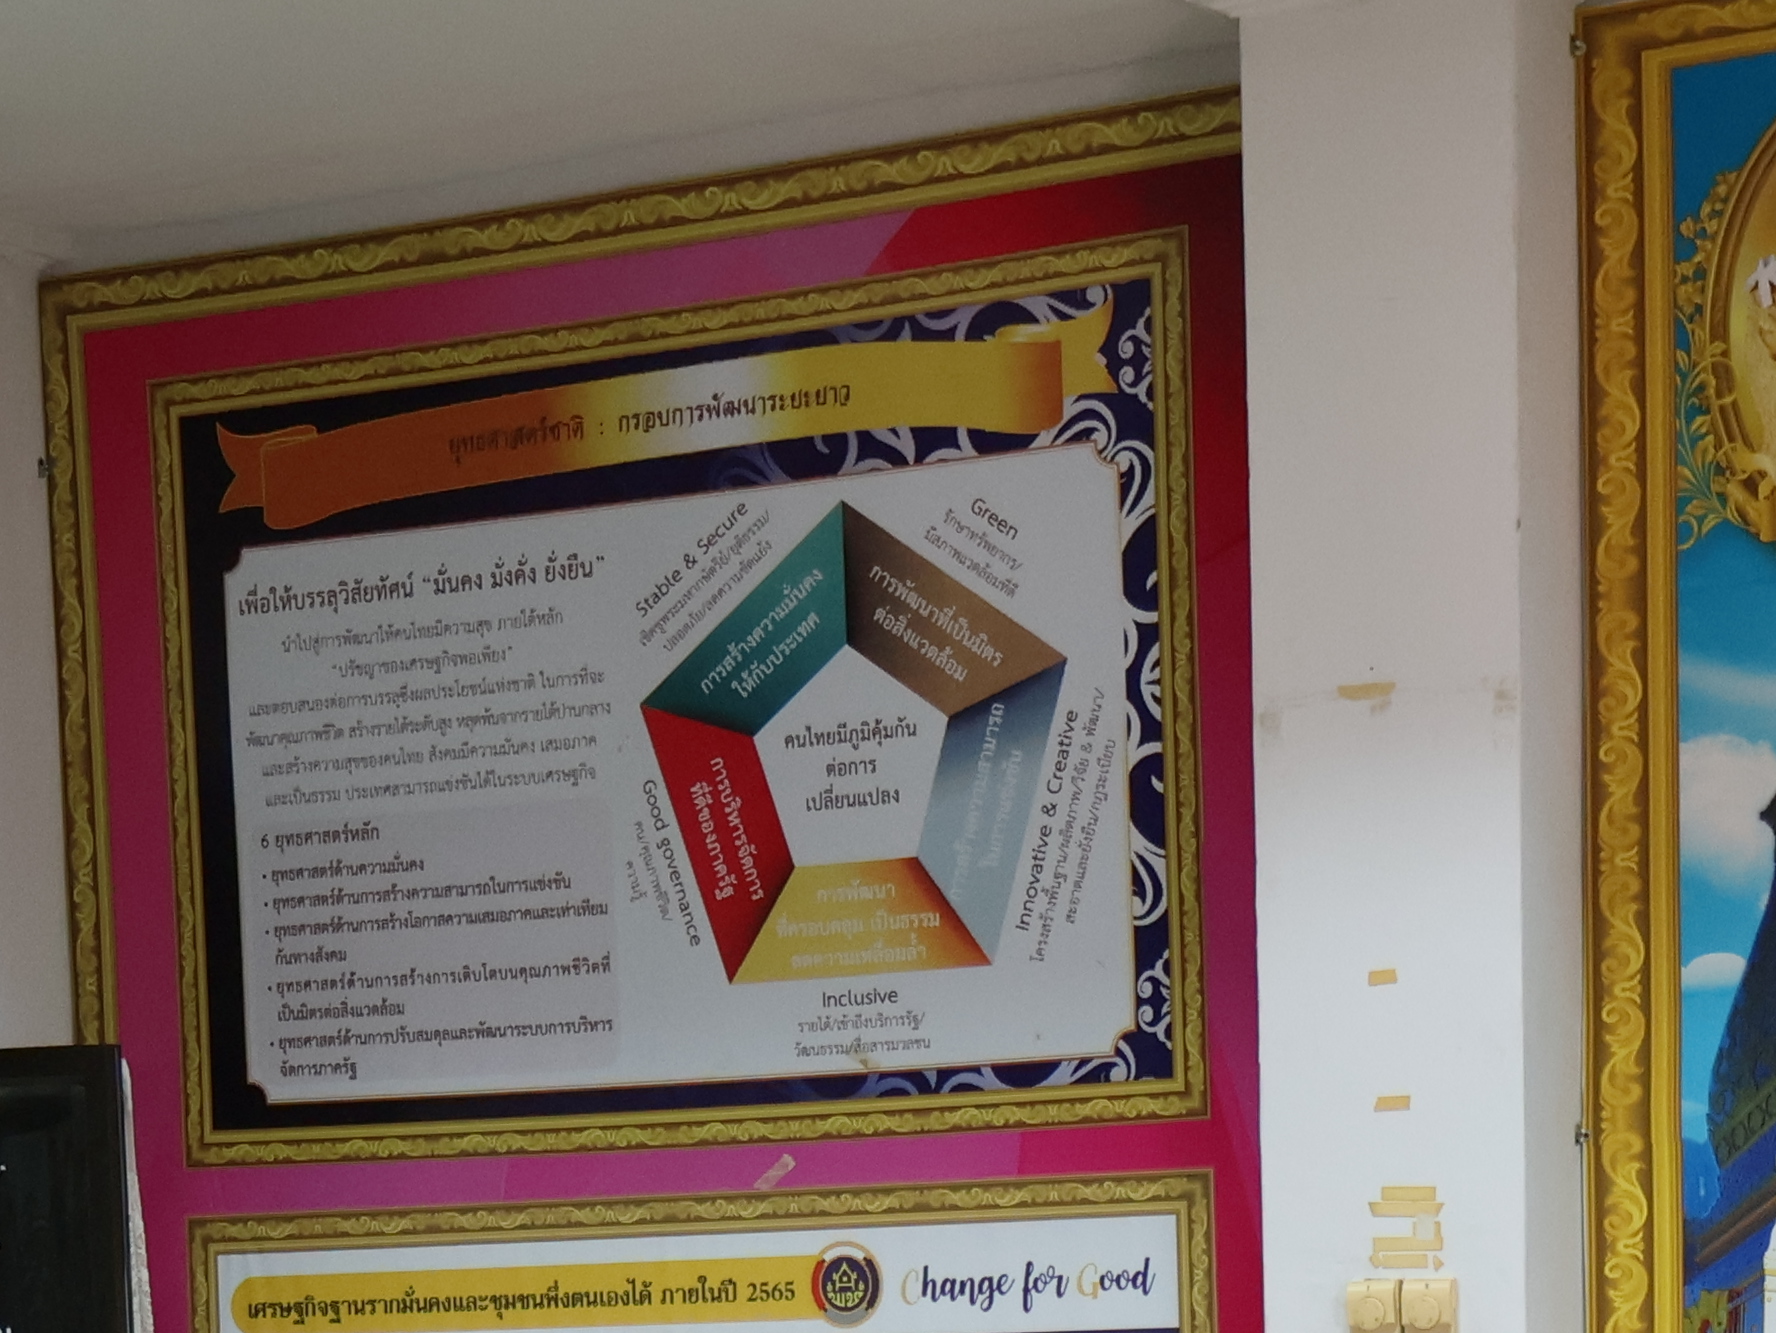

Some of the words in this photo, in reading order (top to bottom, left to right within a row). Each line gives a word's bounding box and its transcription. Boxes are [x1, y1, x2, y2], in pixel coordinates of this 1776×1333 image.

[971, 497, 1019, 541] Green
[636, 568, 684, 619] Stable
[684, 552, 699, 570] &
[697, 501, 749, 555] Secure
[872, 606, 968, 682] ต่อสิ่งแวดล้อม
[825, 757, 878, 779] ต่อการ
[1047, 709, 1079, 796] Creative
[643, 779, 670, 832] Good
[805, 785, 901, 814] เปลี่ยนแปลง
[1041, 803, 1059, 818] &
[656, 837, 701, 948] governance
[1015, 824, 1054, 932] Innovative
[821, 988, 899, 1008] Inclusive
[247, 1276, 653, 1330] เศรษฐกิจฐานรากมั่นคงและชุมชนพึ่งตนเองได้
[660, 1276, 737, 1308] ภายในปี
[746, 1281, 796, 1303] 2565
[900, 1264, 1015, 1312] Change
[1022, 1260, 1069, 1313] for
[1076, 1256, 1156, 1300] Good
